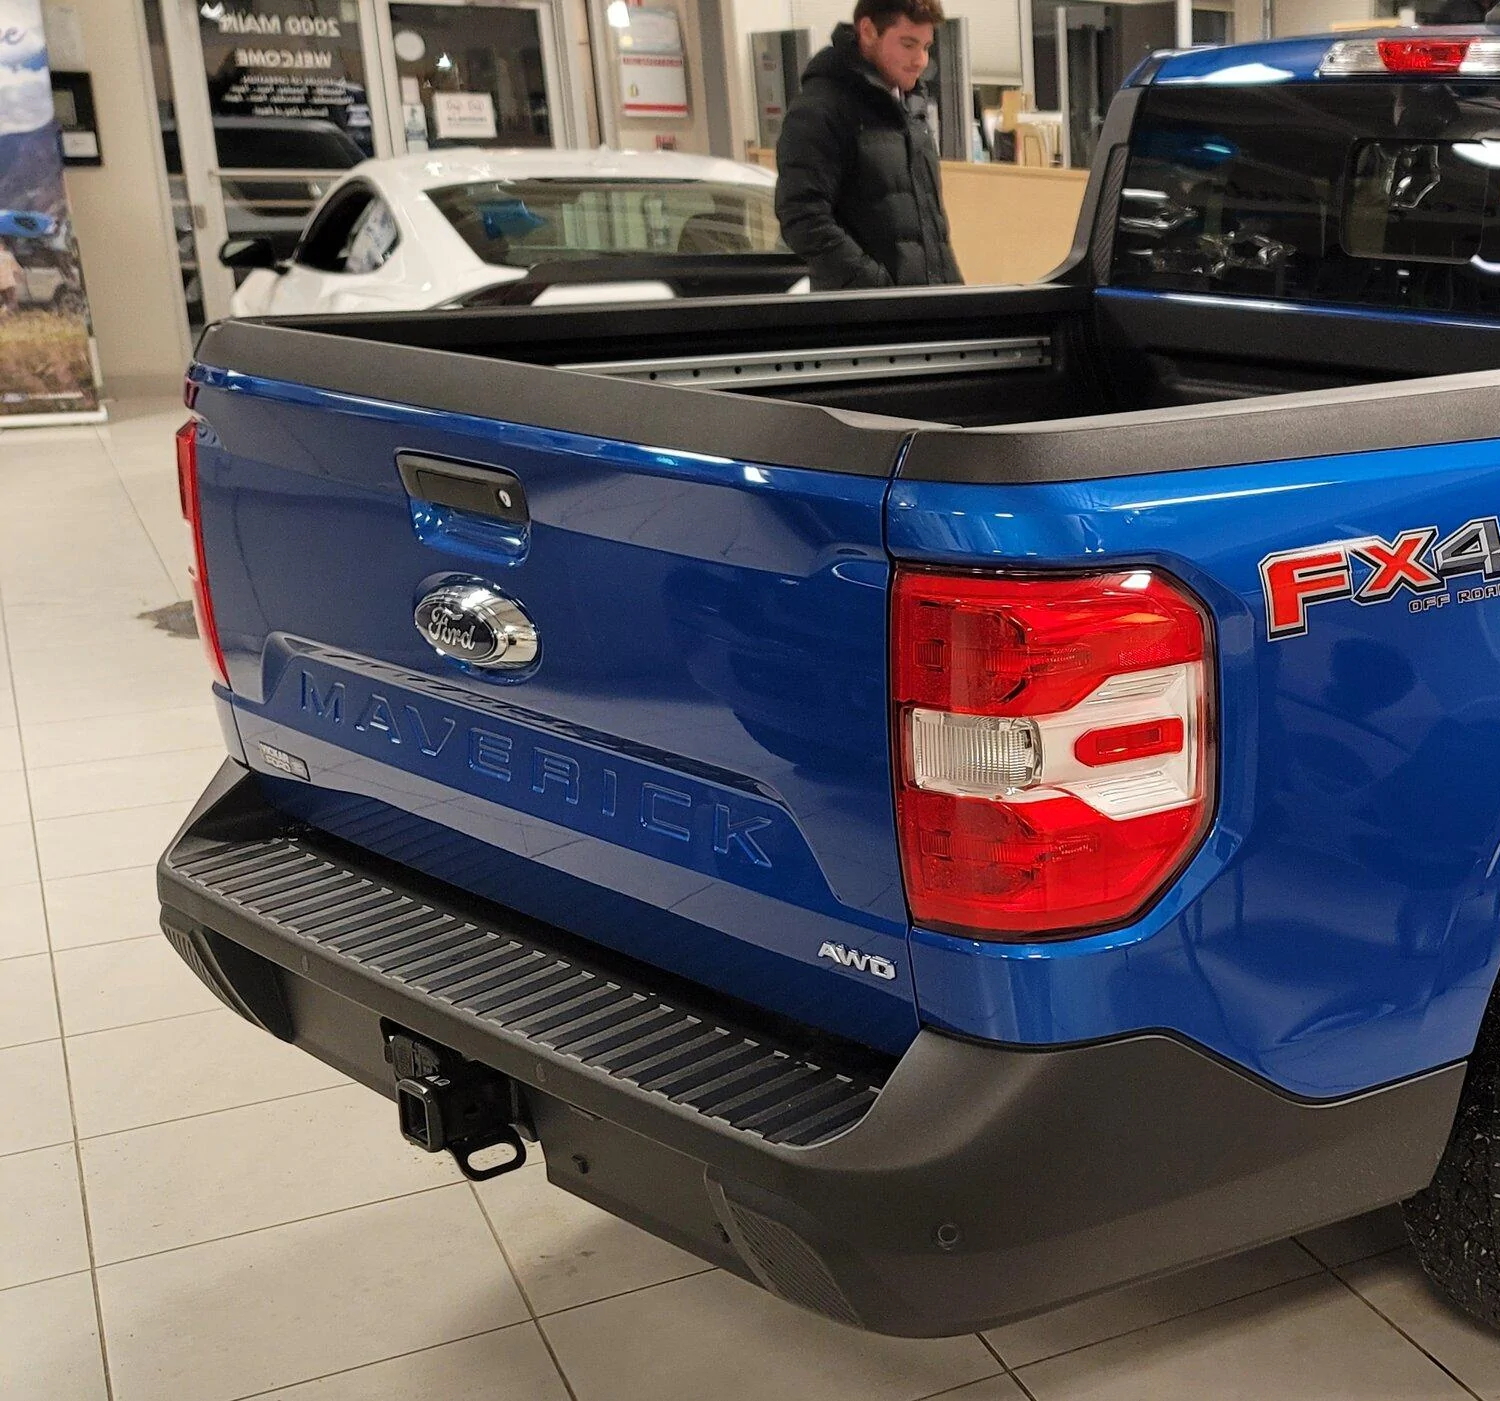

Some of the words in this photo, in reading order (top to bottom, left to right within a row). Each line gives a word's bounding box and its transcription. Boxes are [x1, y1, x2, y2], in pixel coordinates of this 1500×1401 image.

[1408, 594, 1450, 614] OFF
[428, 606, 476, 651] Ford
[300, 670, 773, 868] MAVERICK
[817, 940, 898, 980] AWD
